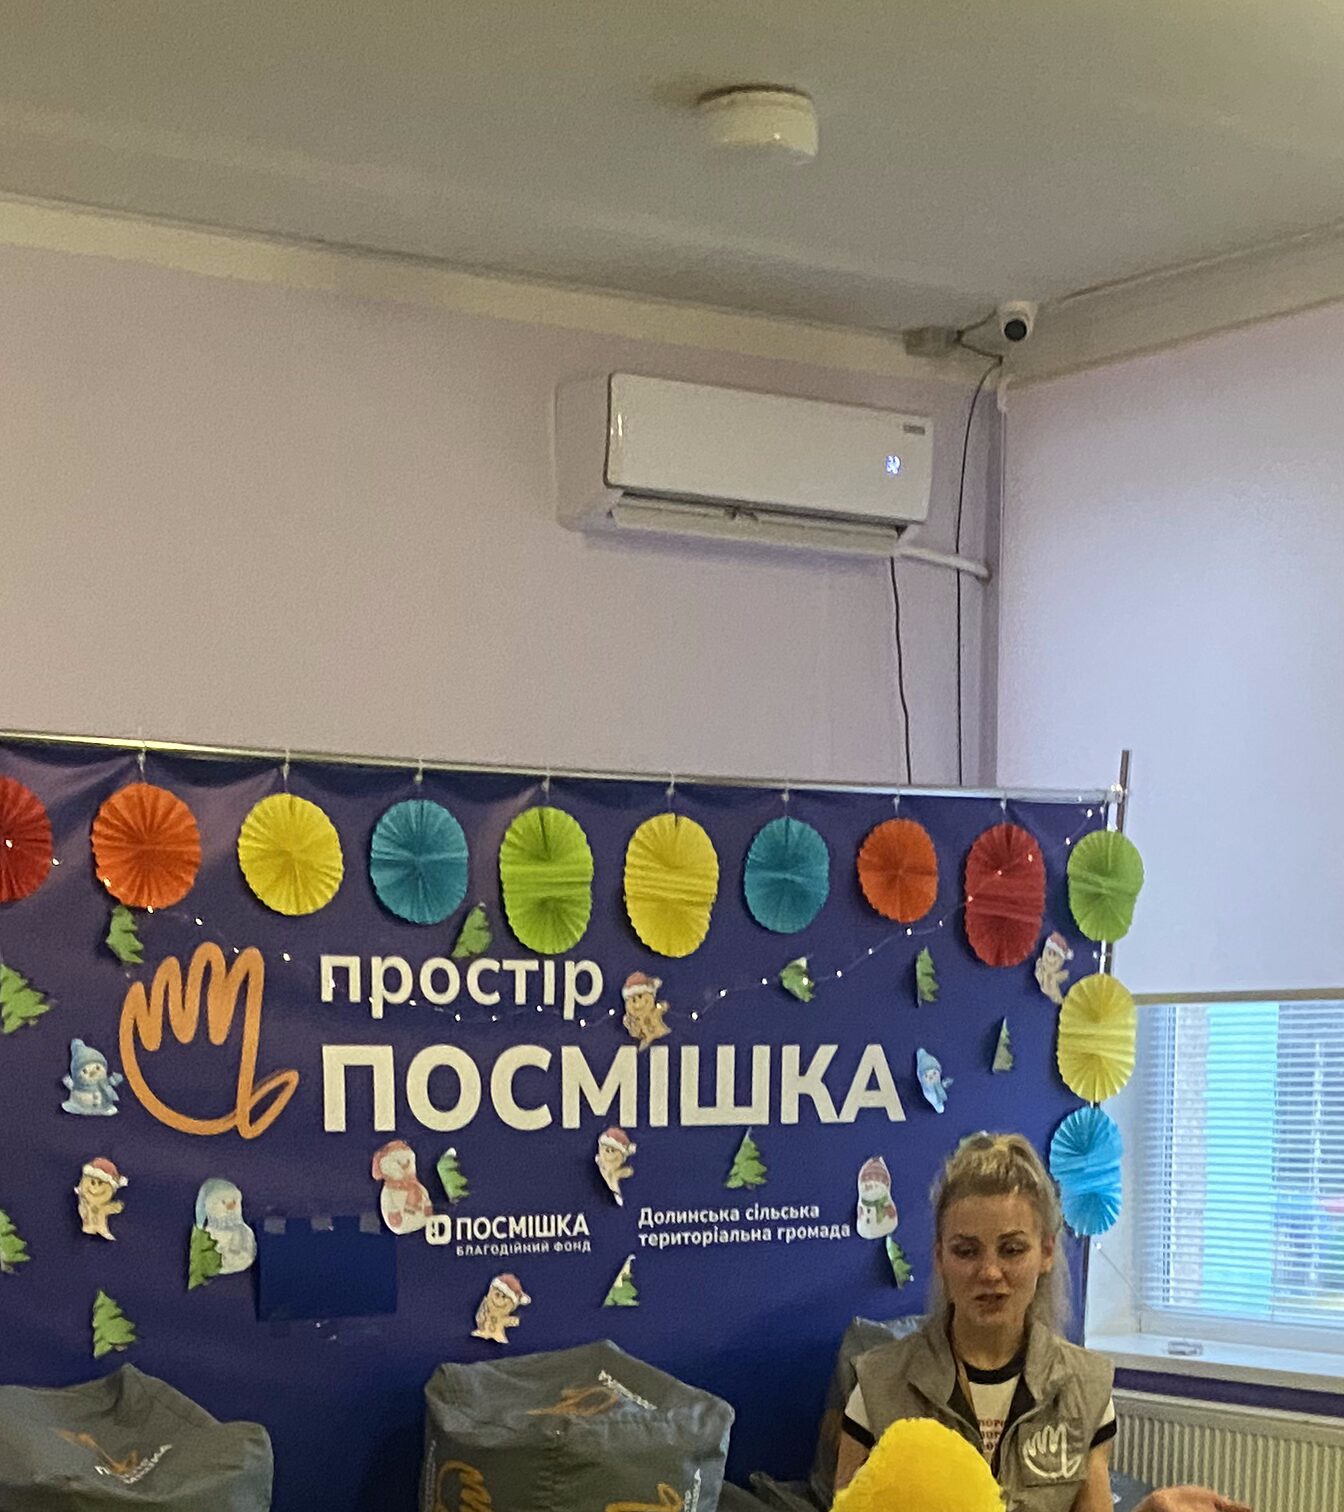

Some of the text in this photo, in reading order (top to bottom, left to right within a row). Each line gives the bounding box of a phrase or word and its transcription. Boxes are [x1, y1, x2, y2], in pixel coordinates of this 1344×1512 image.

[320, 954, 604, 1020] простір
[322, 1043, 906, 1133] ПОСМІШКА
[456, 1213, 590, 1241] ПОСМІШКА
[637, 1202, 820, 1229] Долинська сільська
[456, 1240, 592, 1257] БЛАГОДІЙНИЙ ФОНД
[638, 1223, 851, 1250] територіальна громада
